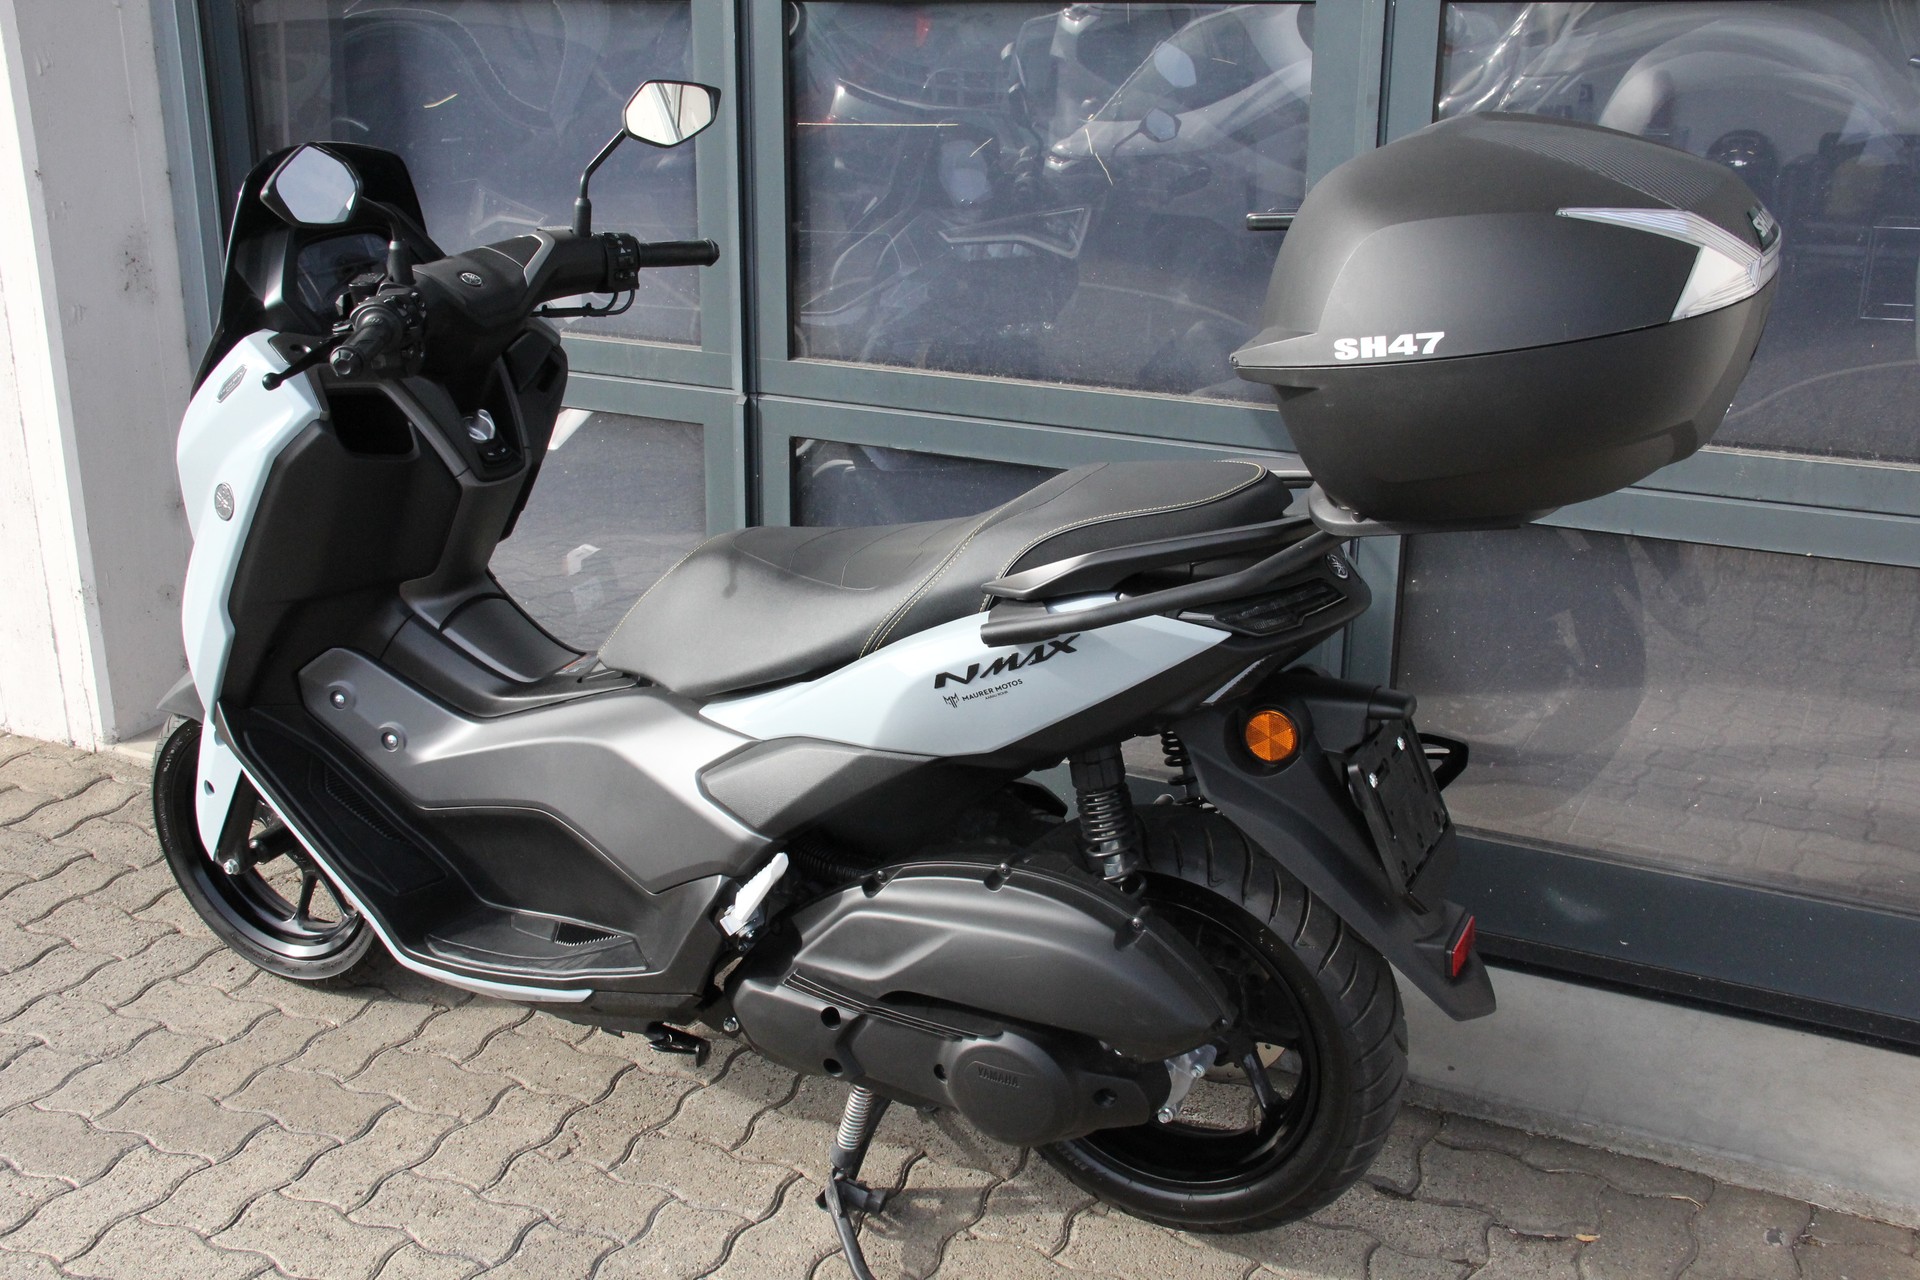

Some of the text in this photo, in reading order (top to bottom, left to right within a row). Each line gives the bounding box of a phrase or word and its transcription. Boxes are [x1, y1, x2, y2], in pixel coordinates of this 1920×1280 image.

[1333, 331, 1445, 361] SH47
[934, 633, 1081, 689] NMAX
[961, 678, 1024, 702] MAURER MOTOS
[978, 1066, 1020, 1088] YAMAHA
